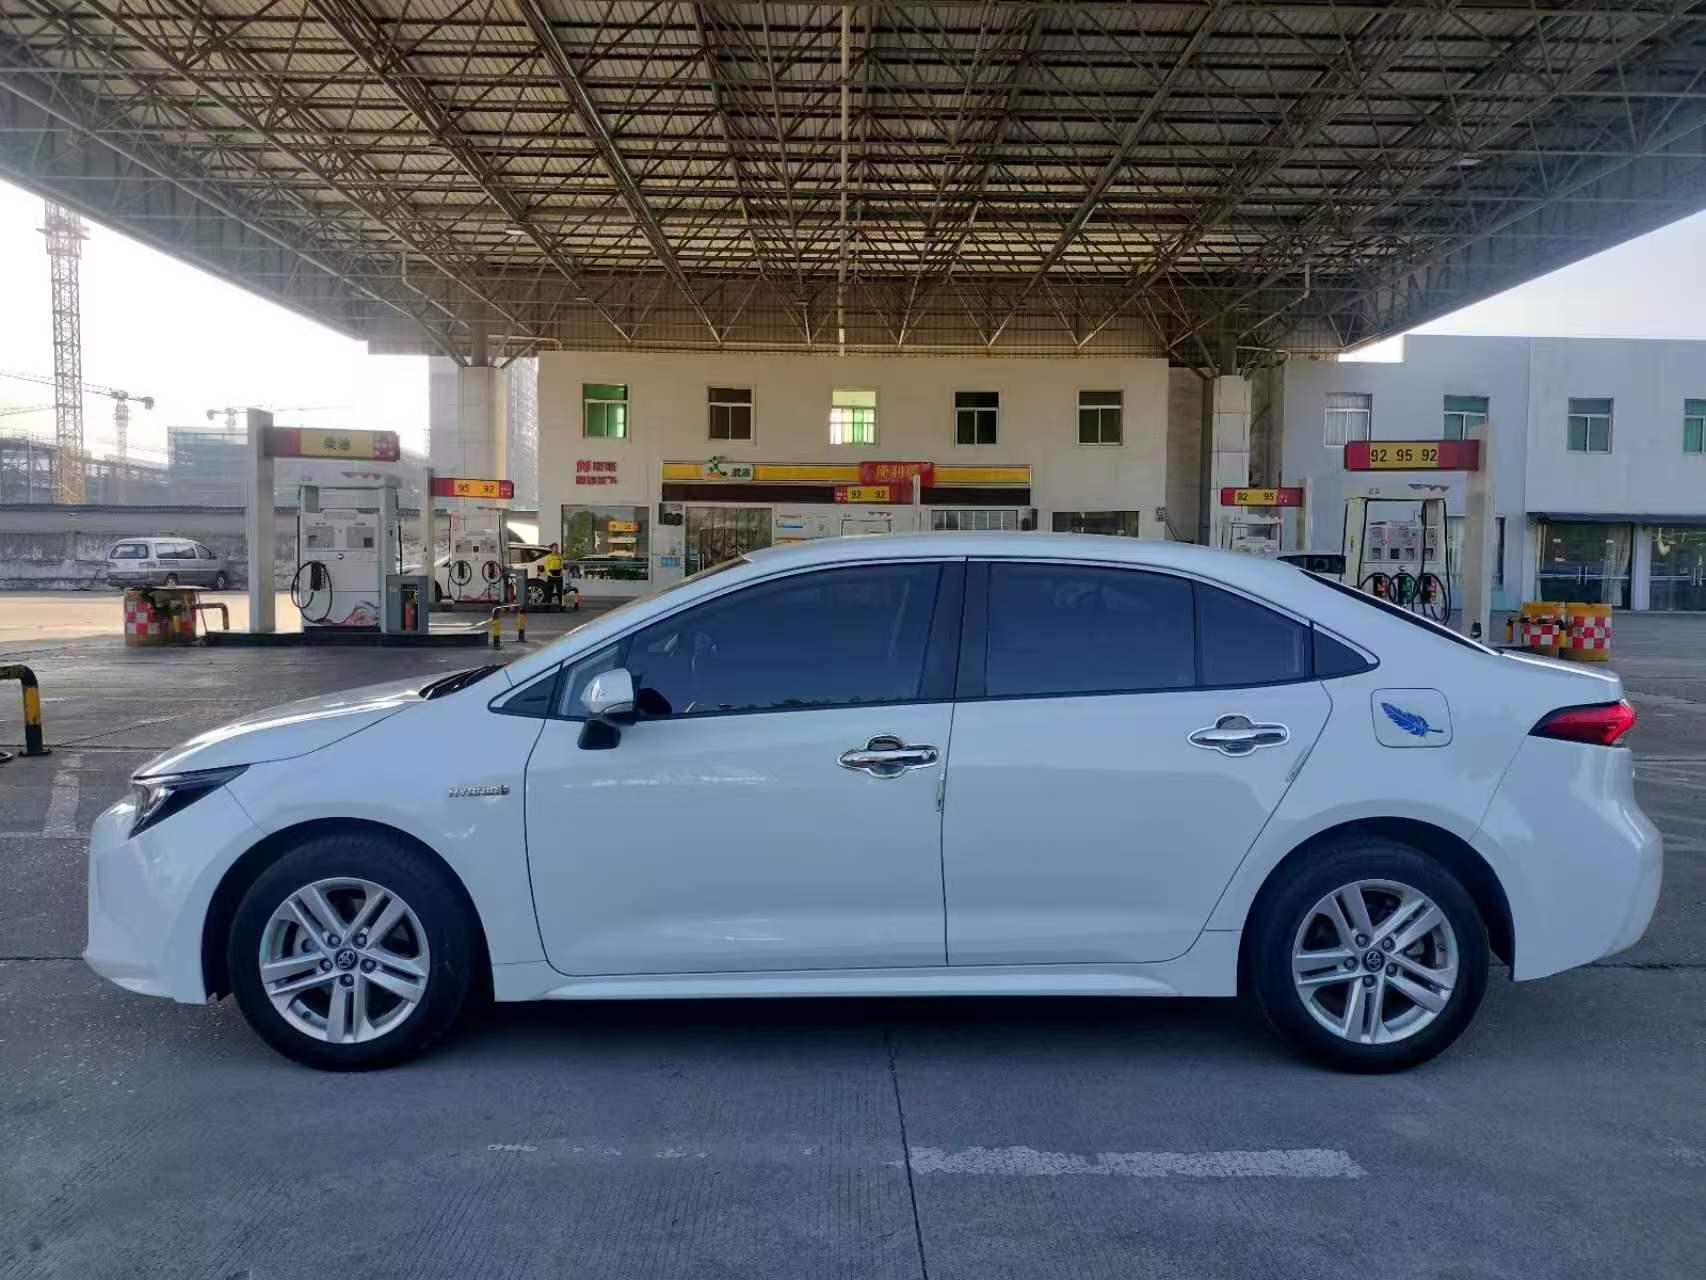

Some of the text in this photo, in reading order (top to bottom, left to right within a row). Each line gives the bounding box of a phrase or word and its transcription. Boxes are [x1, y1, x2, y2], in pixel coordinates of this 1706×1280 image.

[1371, 449, 1437, 462] 92 95 92
[458, 483, 495, 494] 95 92
[851, 490, 886, 499] 92 92
[1237, 492, 1275, 501] 92 95
